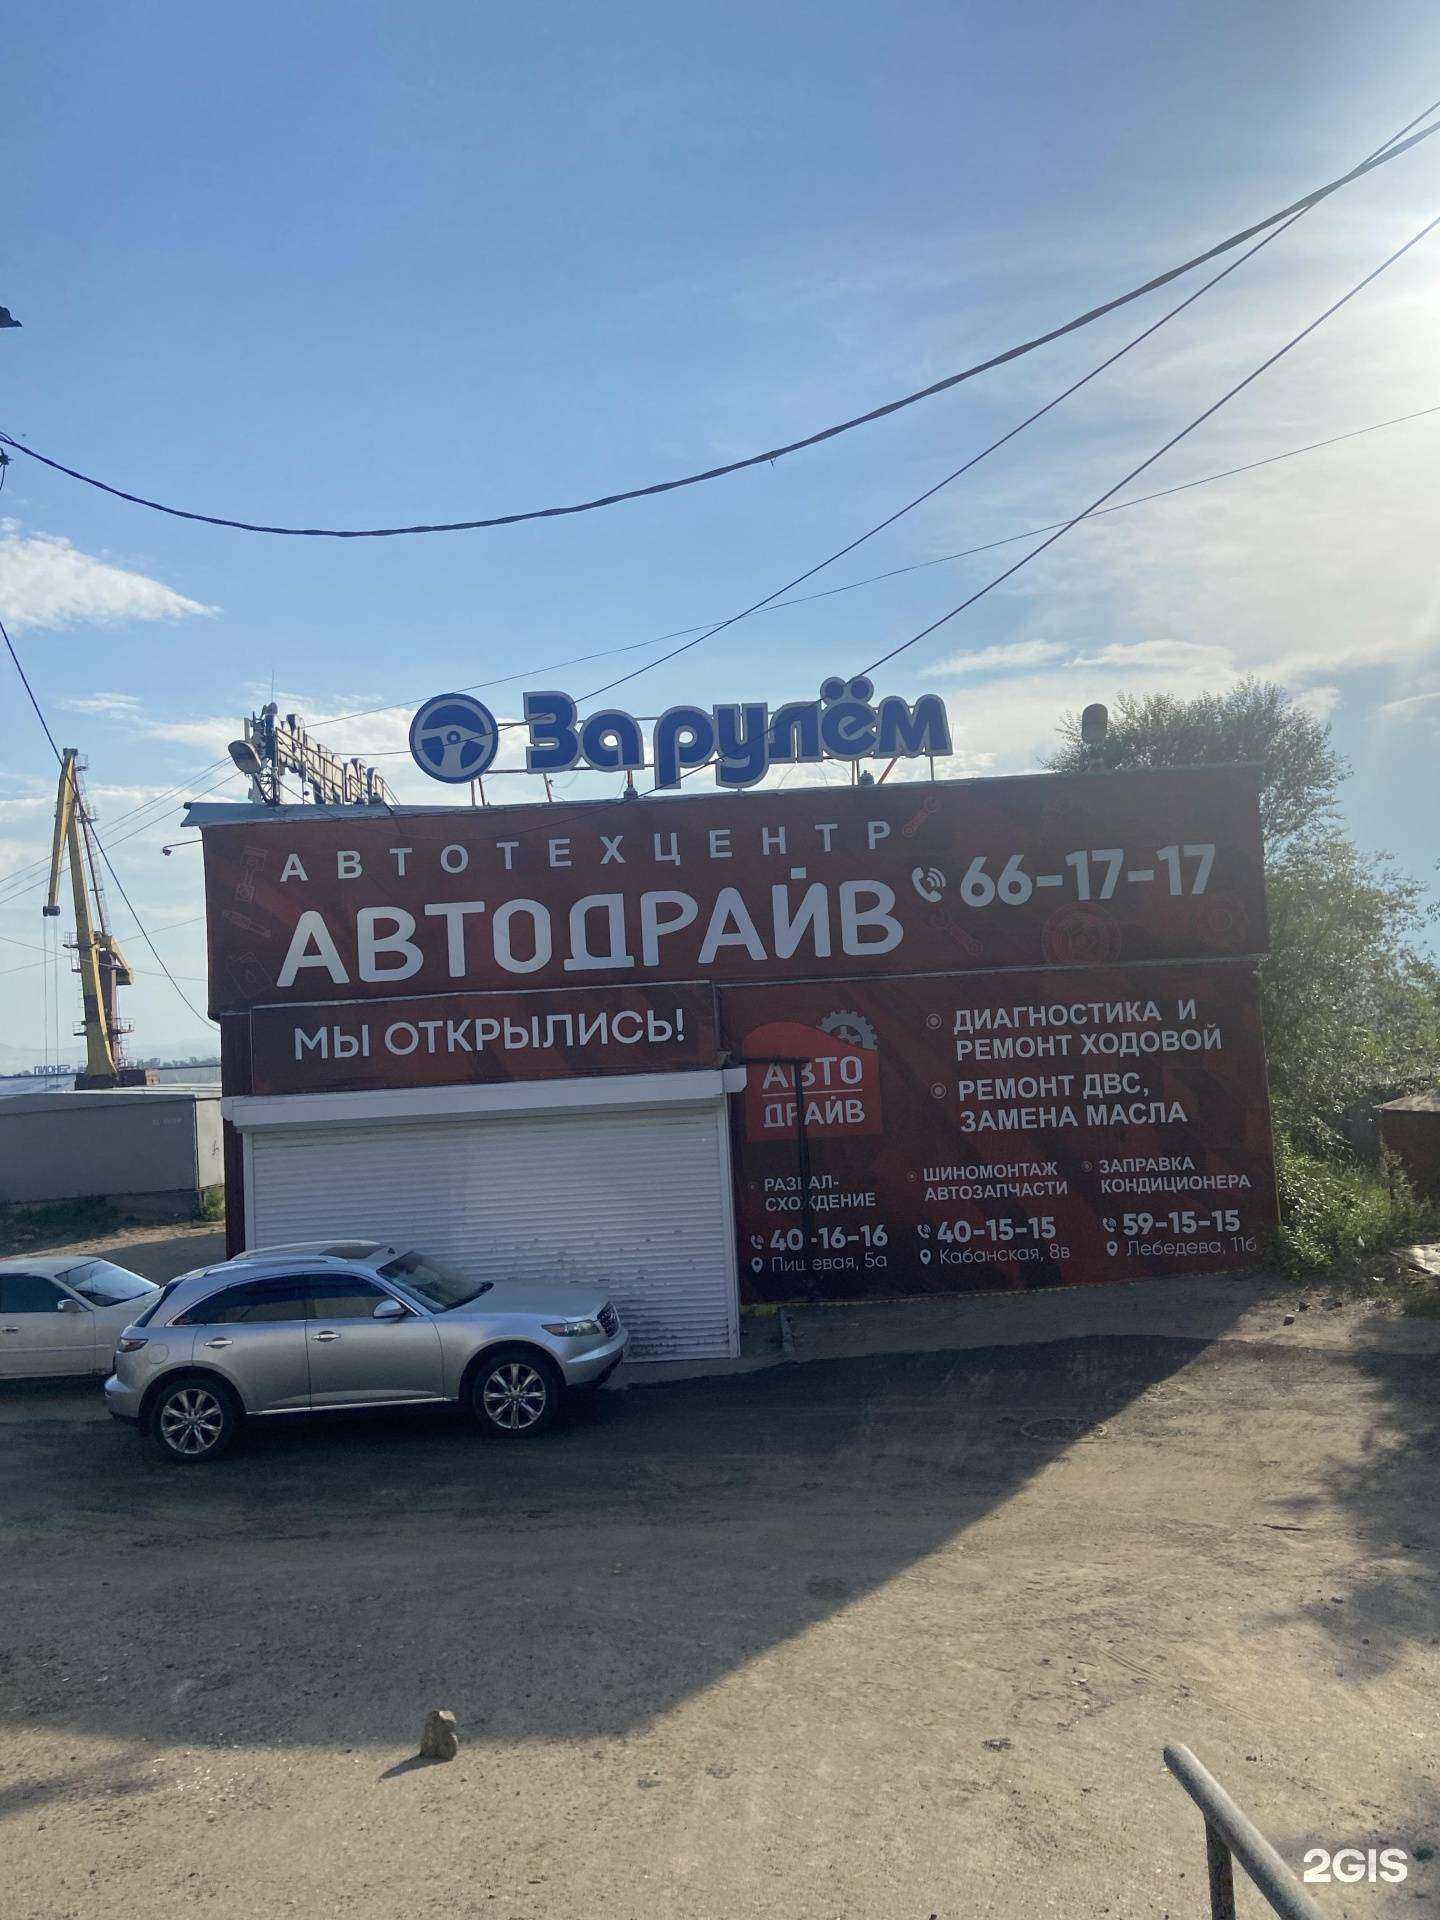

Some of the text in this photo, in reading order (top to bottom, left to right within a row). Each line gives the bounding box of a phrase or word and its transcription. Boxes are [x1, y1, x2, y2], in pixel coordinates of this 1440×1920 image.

[279, 820, 891, 883] АВТОТЕХЦЕНТР
[960, 843, 1215, 907] 66-17-17
[275, 866, 904, 988] АВТОДРАЙВ
[954, 1000, 1197, 1035] ДИАГНОСТИКА И
[293, 1008, 686, 1060] МЫ ОТКРЫЛИСЬ!
[957, 1024, 1222, 1061] РЕМОНТ ХОДОВОЙ
[958, 1072, 1149, 1101] РЕМОНТ ДВС,
[960, 1102, 1188, 1132] ЗАМЕНА МАСЛА
[923, 1162, 1058, 1182] ШИНОМОНТАЖ
[1099, 1156, 1195, 1174] ЗАПРАВКА
[924, 1181, 1068, 1202] АВТОЗАПЧАСТИ
[1101, 1174, 1252, 1194] КОНДИЦИОНЕРА
[937, 1216, 1057, 1243] 40-15-15
[1123, 1209, 1241, 1236] 59-15-15
[864, 1252, 888, 1268] 5а
[940, 1248, 1045, 1265] Кабанская,
